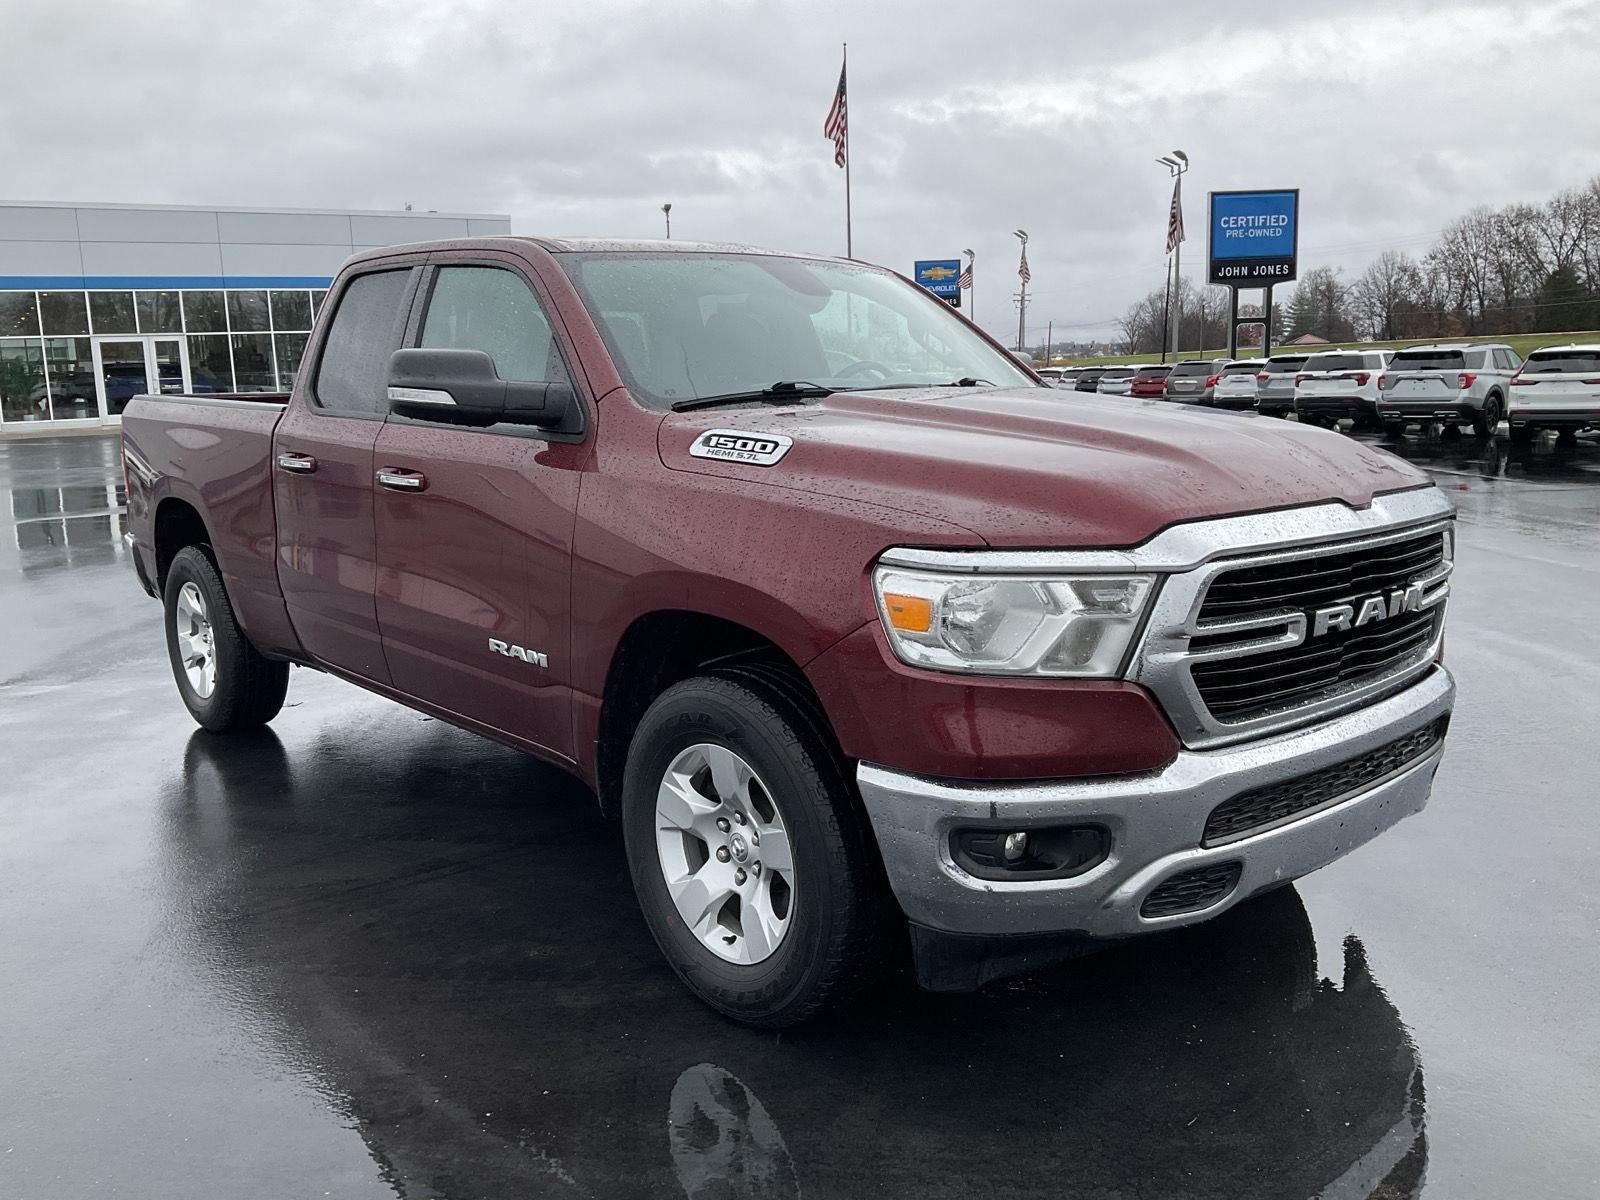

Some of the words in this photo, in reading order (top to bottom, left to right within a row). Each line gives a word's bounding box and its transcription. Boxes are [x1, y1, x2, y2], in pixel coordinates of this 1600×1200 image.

[1220, 215, 1288, 228] CERTIFIED
[1226, 228, 1282, 238] PRE-OWNED
[1218, 267, 1248, 277] JOHN
[1253, 265, 1289, 275] JONES
[708, 436, 775, 453] 1500
[706, 448, 734, 458] HEMI
[736, 452, 759, 461] 5.7L
[1313, 585, 1421, 637] RAM
[488, 637, 549, 668] RAM
